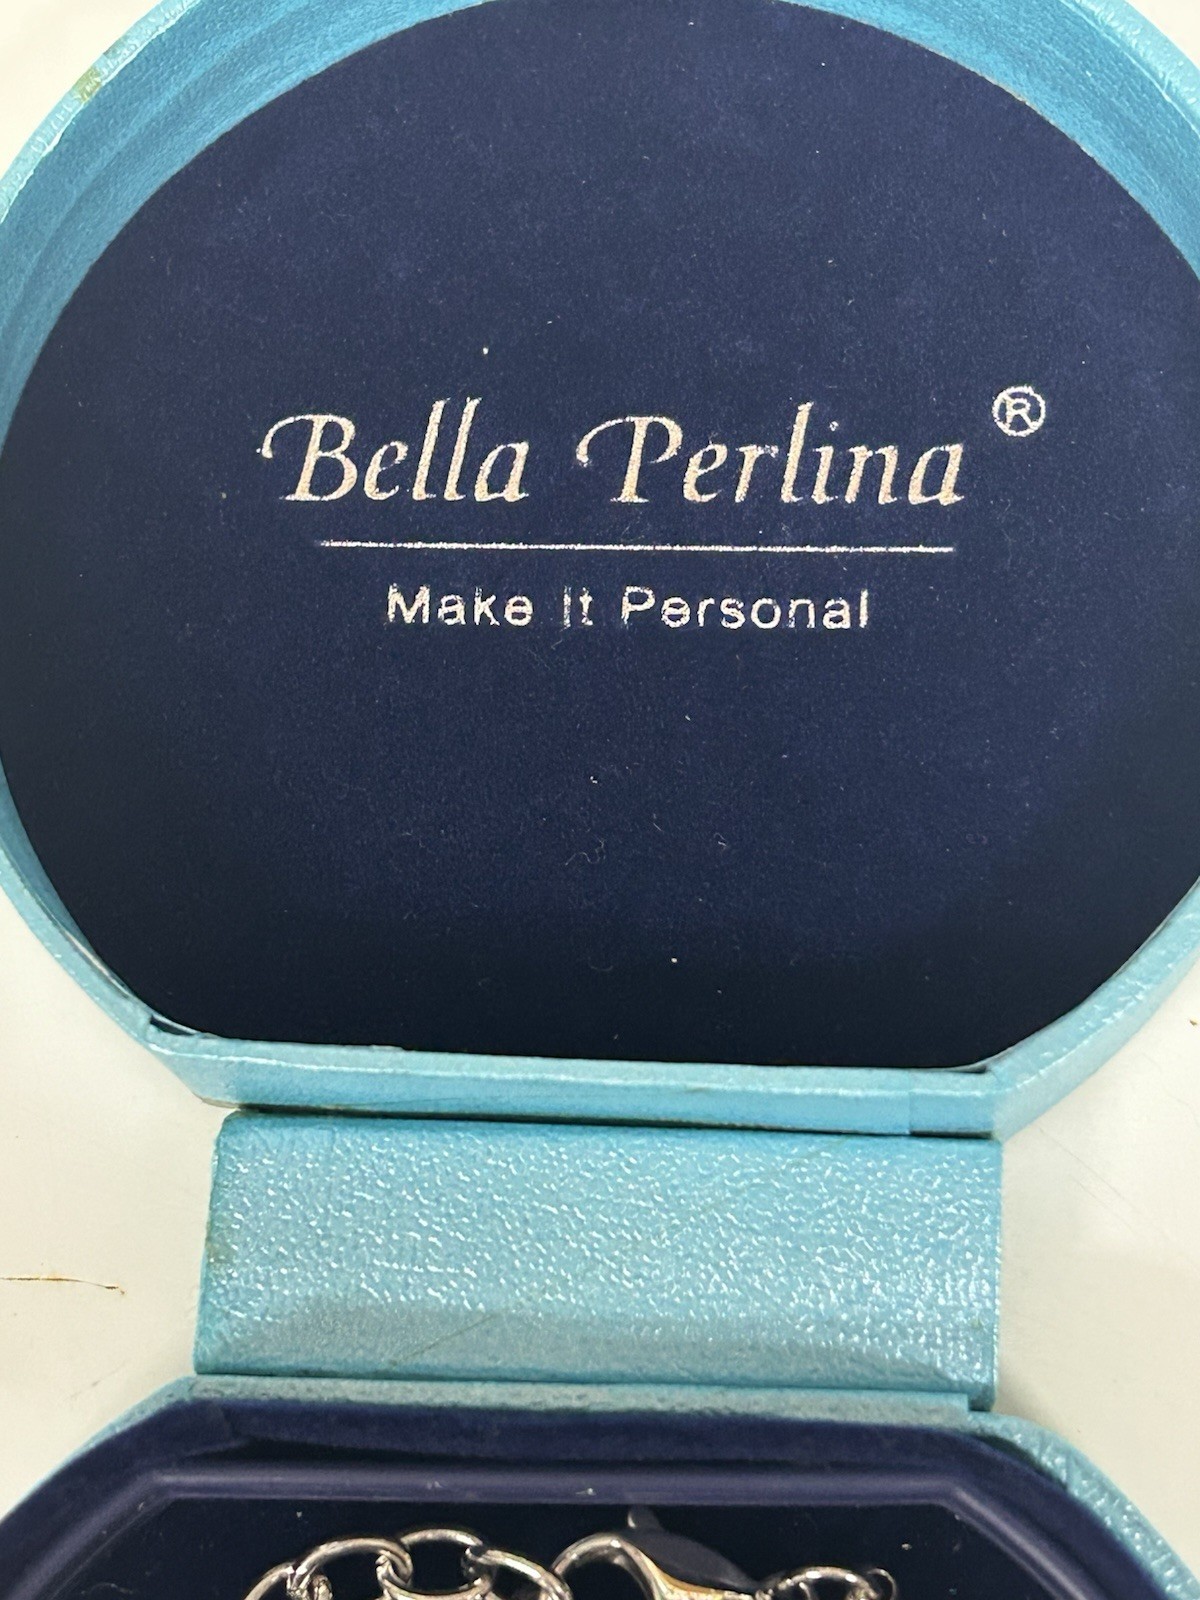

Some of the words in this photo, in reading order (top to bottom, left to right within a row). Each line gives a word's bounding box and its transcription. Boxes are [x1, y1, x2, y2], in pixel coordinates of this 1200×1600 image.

[258, 397, 530, 503] Bella
[575, 402, 965, 507] Perlina
[386, 583, 534, 627] Make
[563, 585, 594, 629] It
[621, 586, 869, 630] Personal
